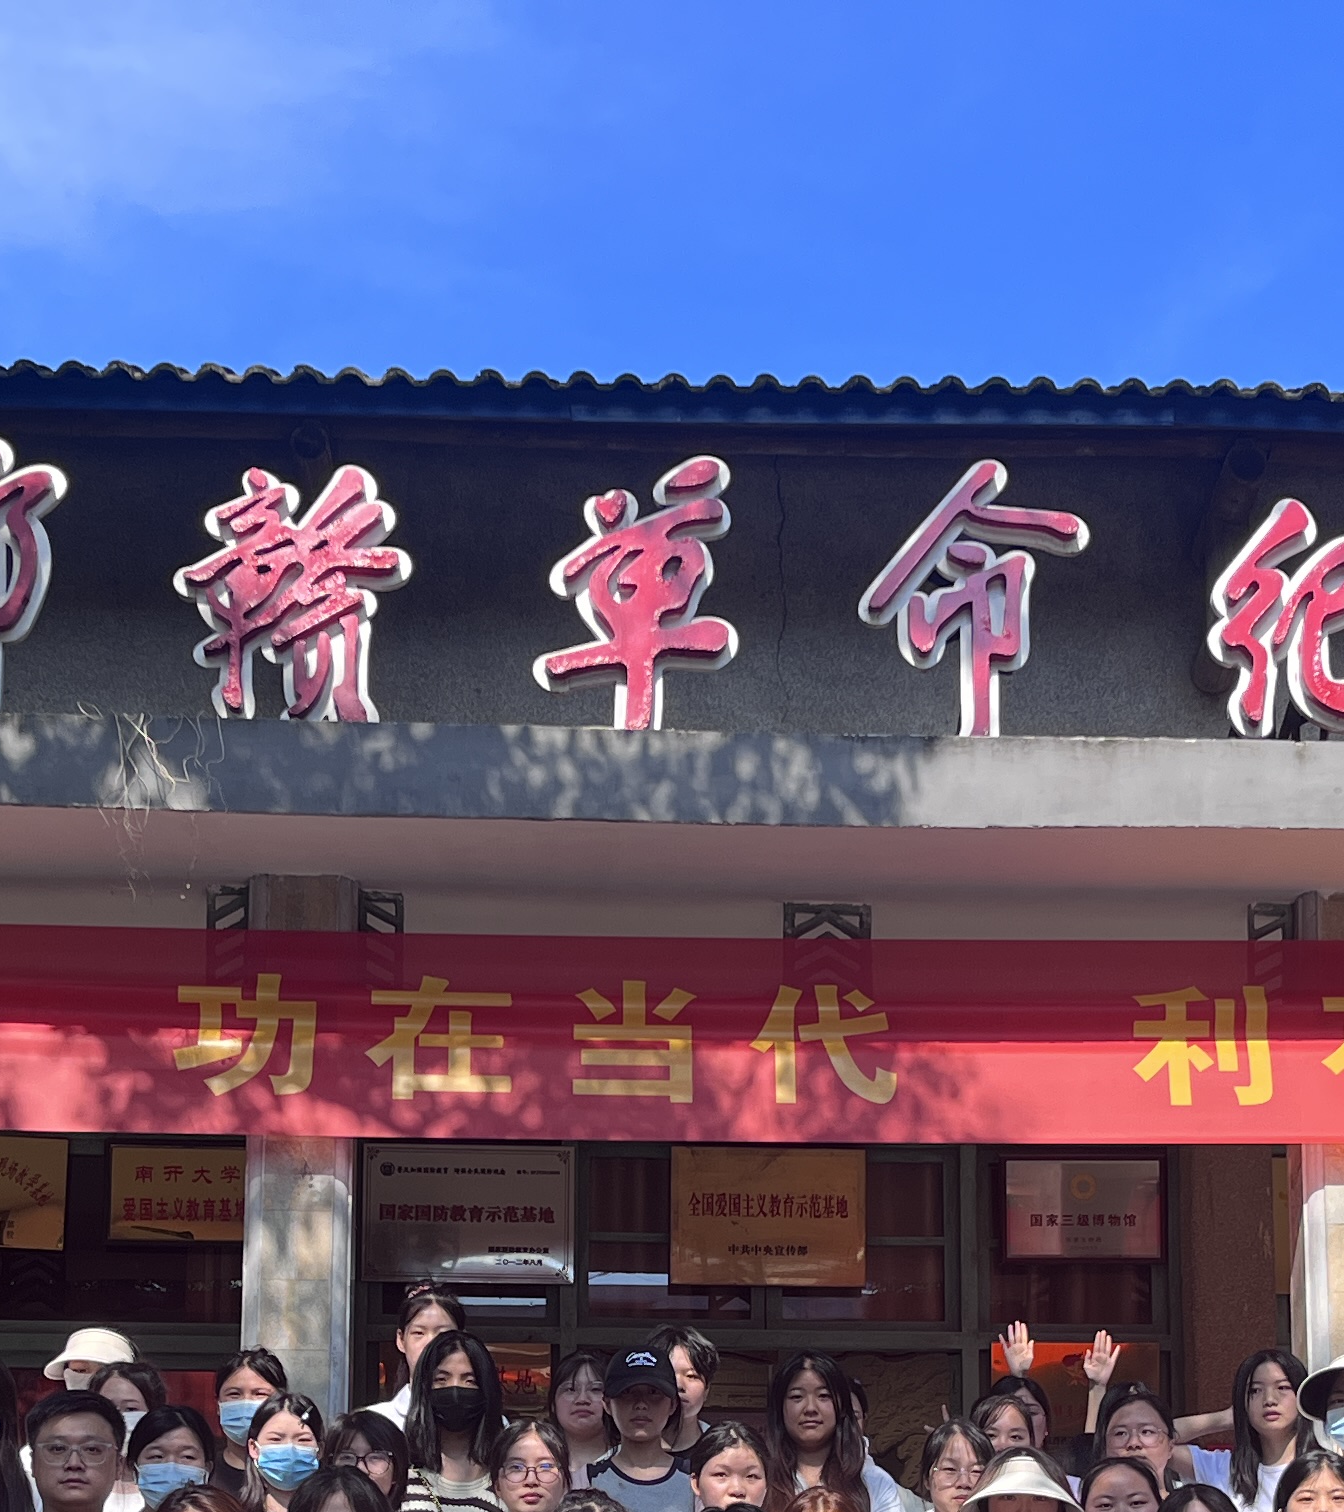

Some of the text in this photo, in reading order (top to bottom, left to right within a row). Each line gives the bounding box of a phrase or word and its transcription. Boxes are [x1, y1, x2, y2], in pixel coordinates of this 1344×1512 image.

[172, 973, 899, 1104] 功在当代
[135, 1165, 241, 1184] 南开大学
[379, 1203, 556, 1223] 国家国防教育示范基地
[688, 1192, 849, 1219] 全国爱国主义教育示范基地
[1030, 1213, 1137, 1228] 国家三级博物馆
[728, 1244, 809, 1256] 中共中央宣传部
